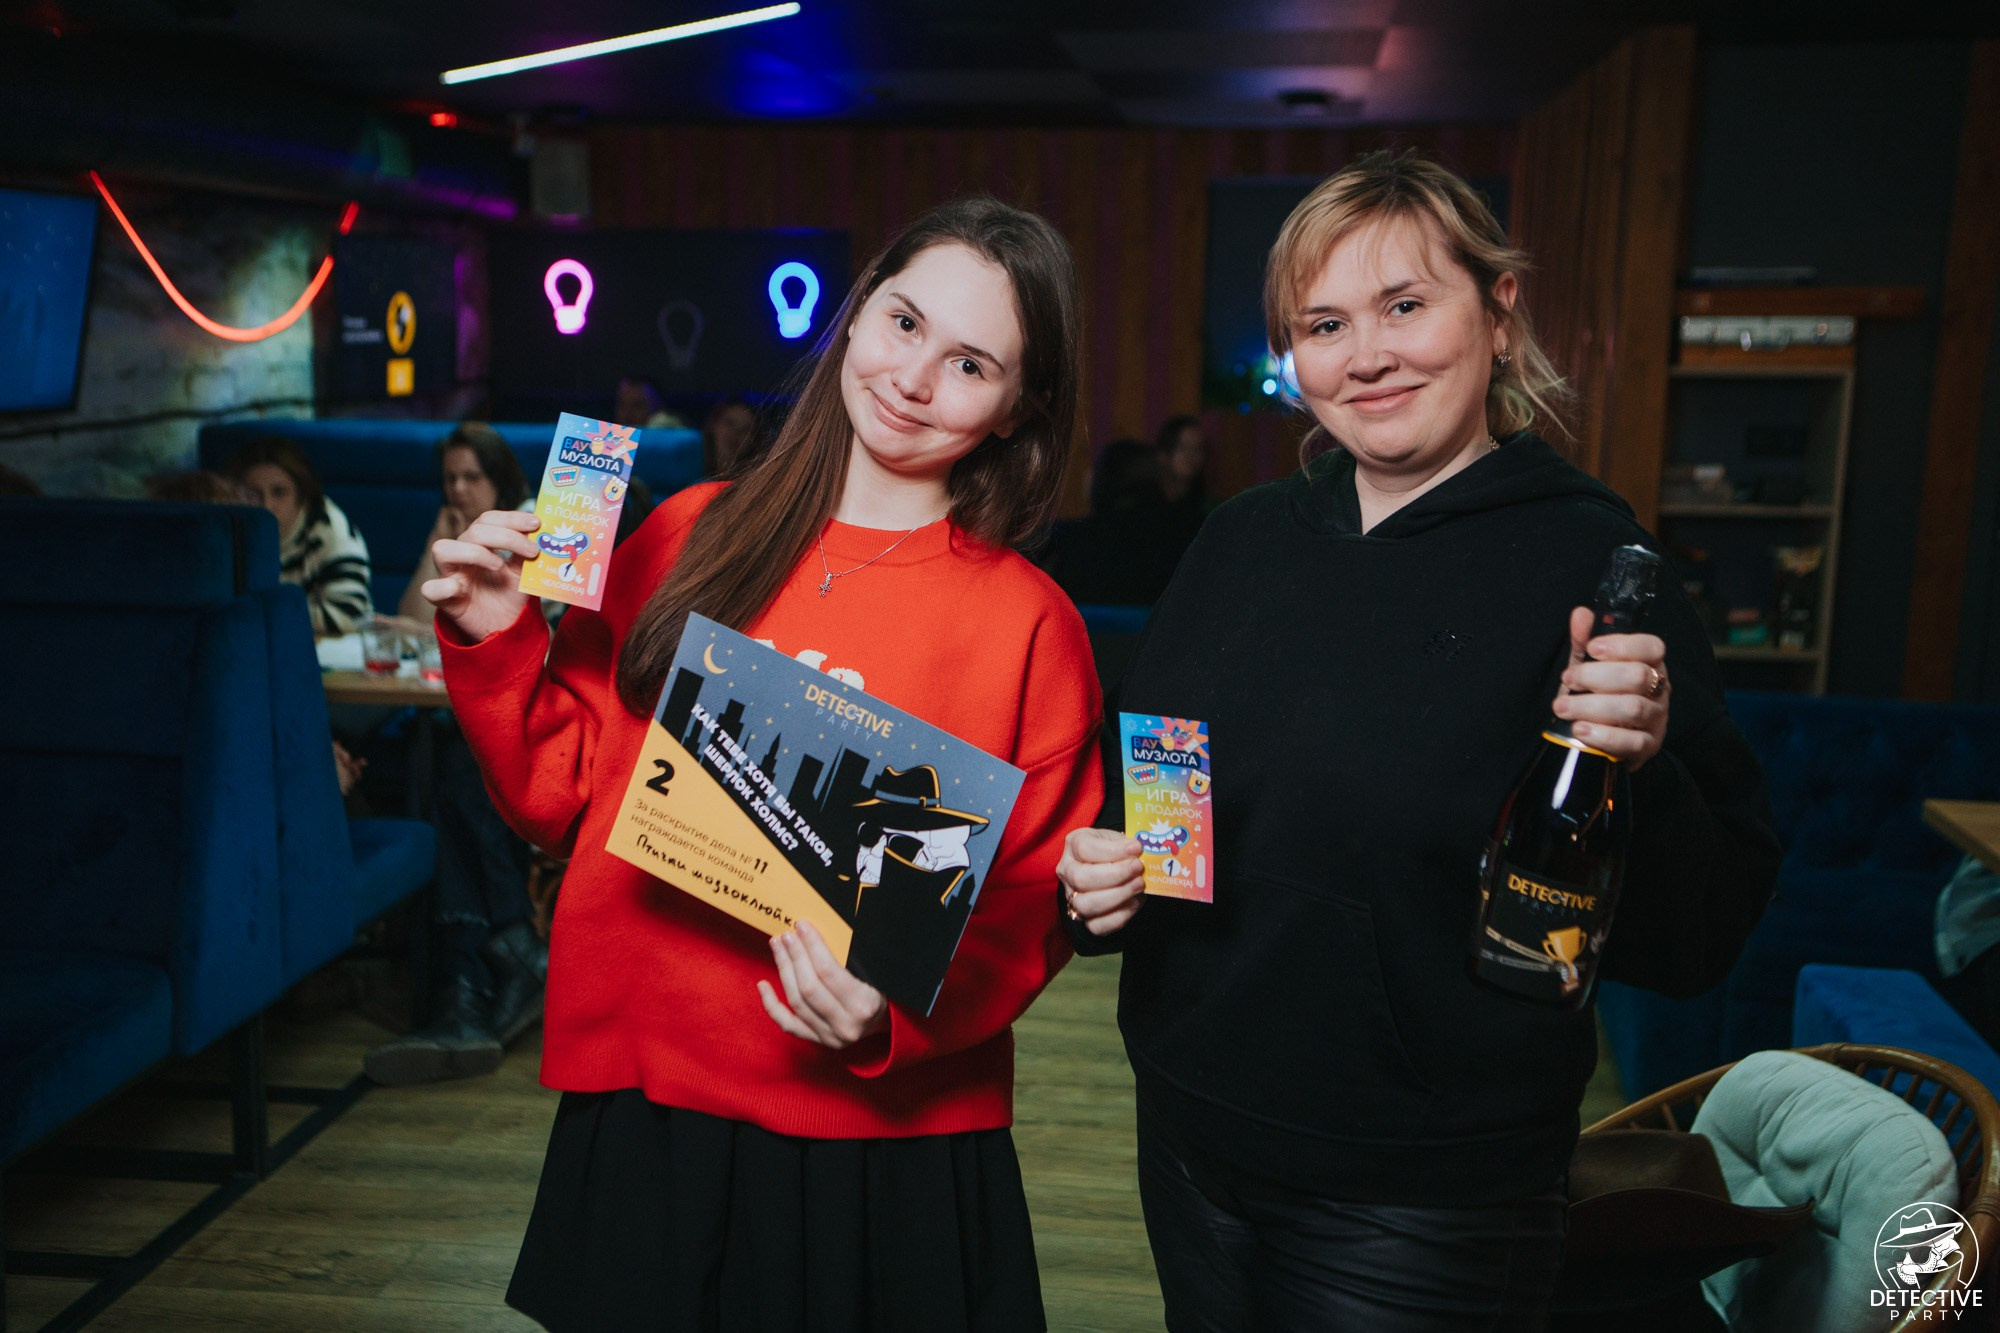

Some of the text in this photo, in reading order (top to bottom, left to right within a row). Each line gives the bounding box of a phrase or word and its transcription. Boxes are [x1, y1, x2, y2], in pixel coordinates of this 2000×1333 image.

[564, 438, 589, 451] ВАУ
[560, 449, 620, 472] МУЗЛОТА
[544, 504, 610, 528] В ПОДАРОК
[560, 490, 600, 512] ИГРА
[805, 683, 894, 739] DETECTIVE
[815, 706, 873, 742] PARTY
[1133, 737, 1158, 750] ВАУ
[1134, 748, 1198, 767] МУЗЛОТА
[645, 758, 675, 797] 2
[690, 702, 835, 868] КАК ТЕБЕ ХОТЯ БЫ ТАКОЕ,
[703, 743, 799, 851] ШЕРЛОК ХОЛМС?
[1135, 802, 1203, 820] В ПОДАРОК
[1146, 787, 1191, 806] ИГРА
[630, 814, 755, 884] награждается команда
[633, 798, 769, 875] За раскрытие дела № 11
[636, 834, 687, 871] Птички
[1167, 859, 1174, 877] 1
[1507, 873, 1597, 911] DETECTIVE
